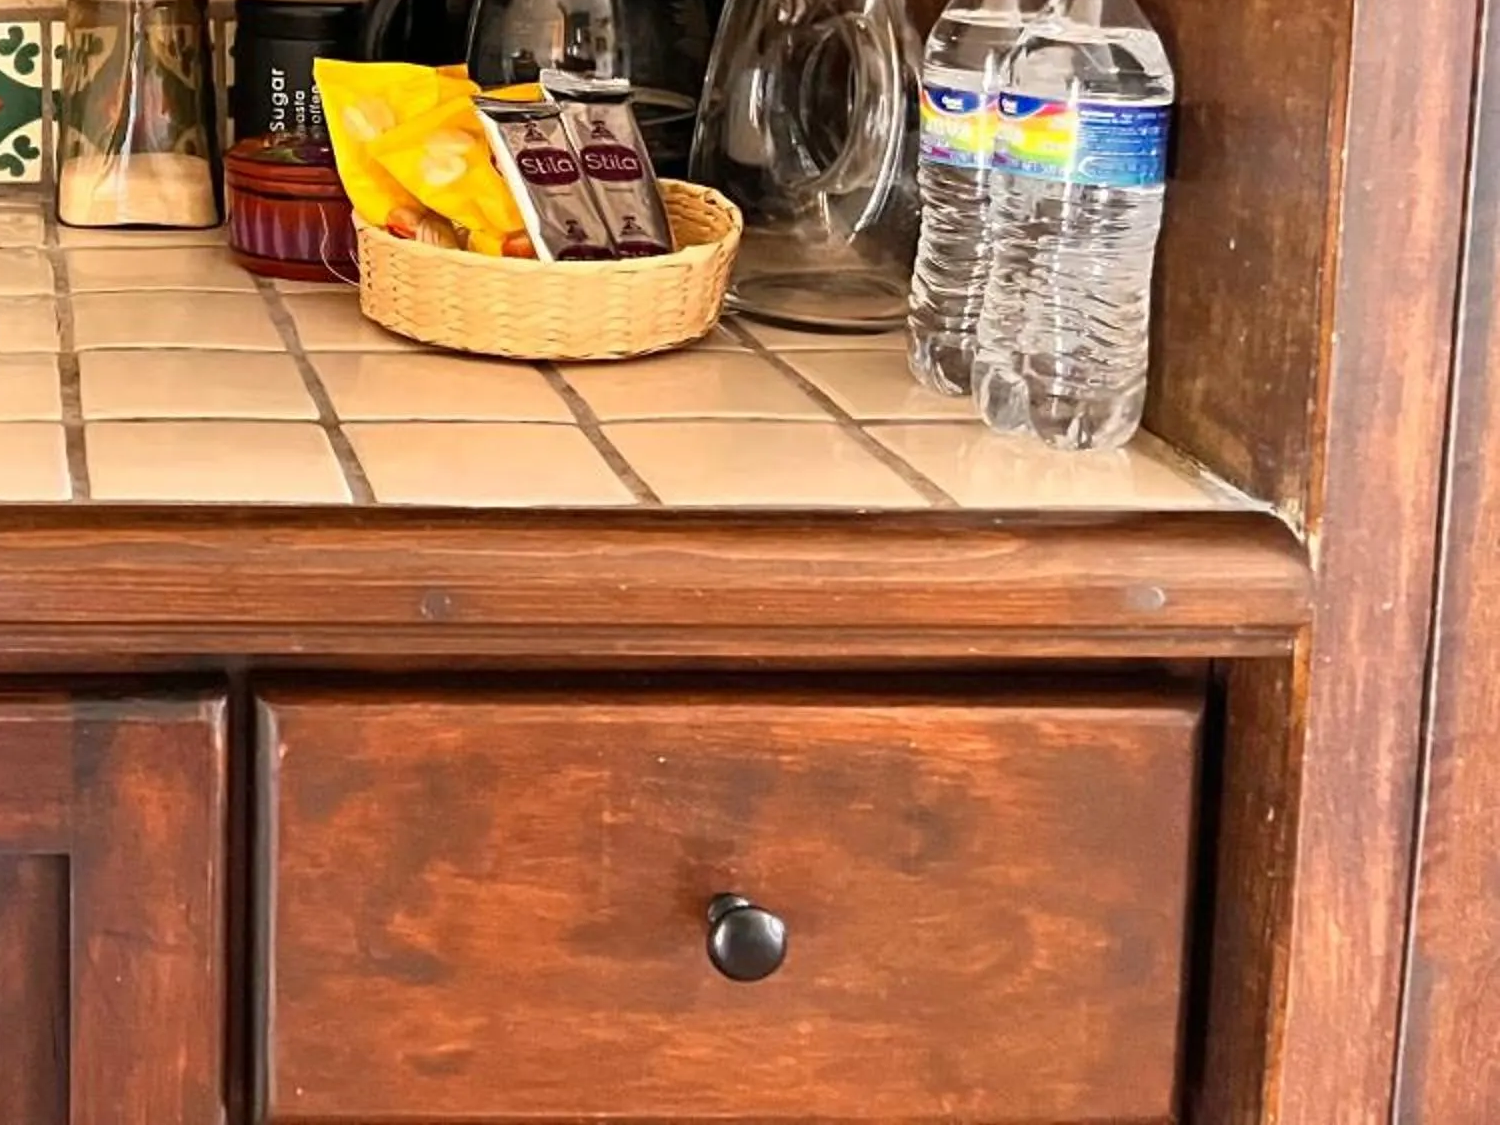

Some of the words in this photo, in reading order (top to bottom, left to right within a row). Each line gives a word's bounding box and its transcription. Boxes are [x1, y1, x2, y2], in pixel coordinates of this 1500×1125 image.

[269, 68, 289, 132] Sugar
[521, 157, 575, 175] Stila
[584, 153, 639, 171] Stila
